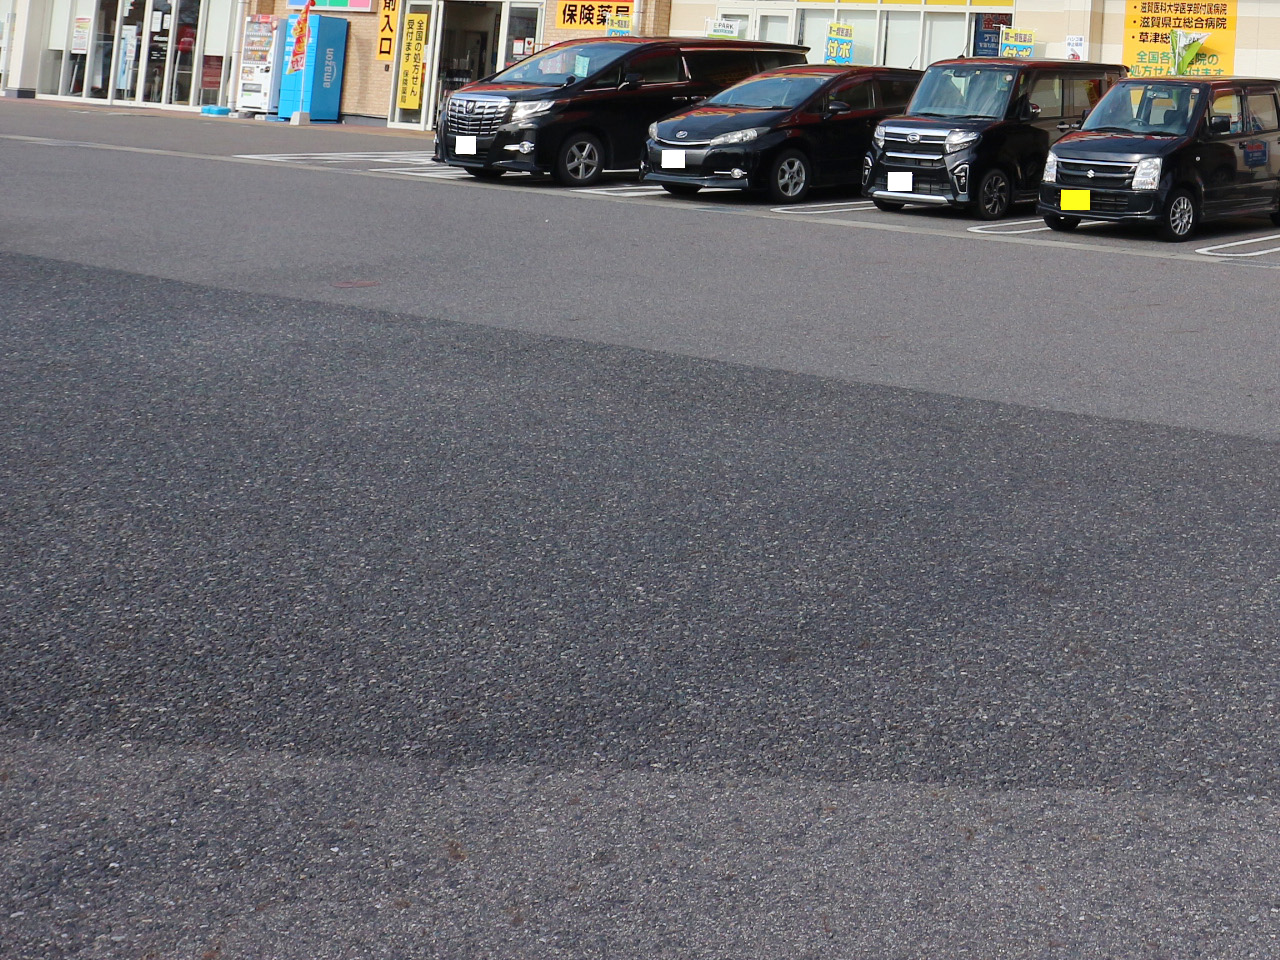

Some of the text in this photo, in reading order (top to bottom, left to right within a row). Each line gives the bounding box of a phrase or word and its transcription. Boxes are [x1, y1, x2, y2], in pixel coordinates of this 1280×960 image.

[402, 19, 415, 63] 受付ます
[1138, 32, 1171, 44] 草津総
[1139, 16, 1227, 30] 滋賀県立総合病院
[323, 48, 334, 88] amazon
[409, 19, 424, 97] 全国の処方せん
